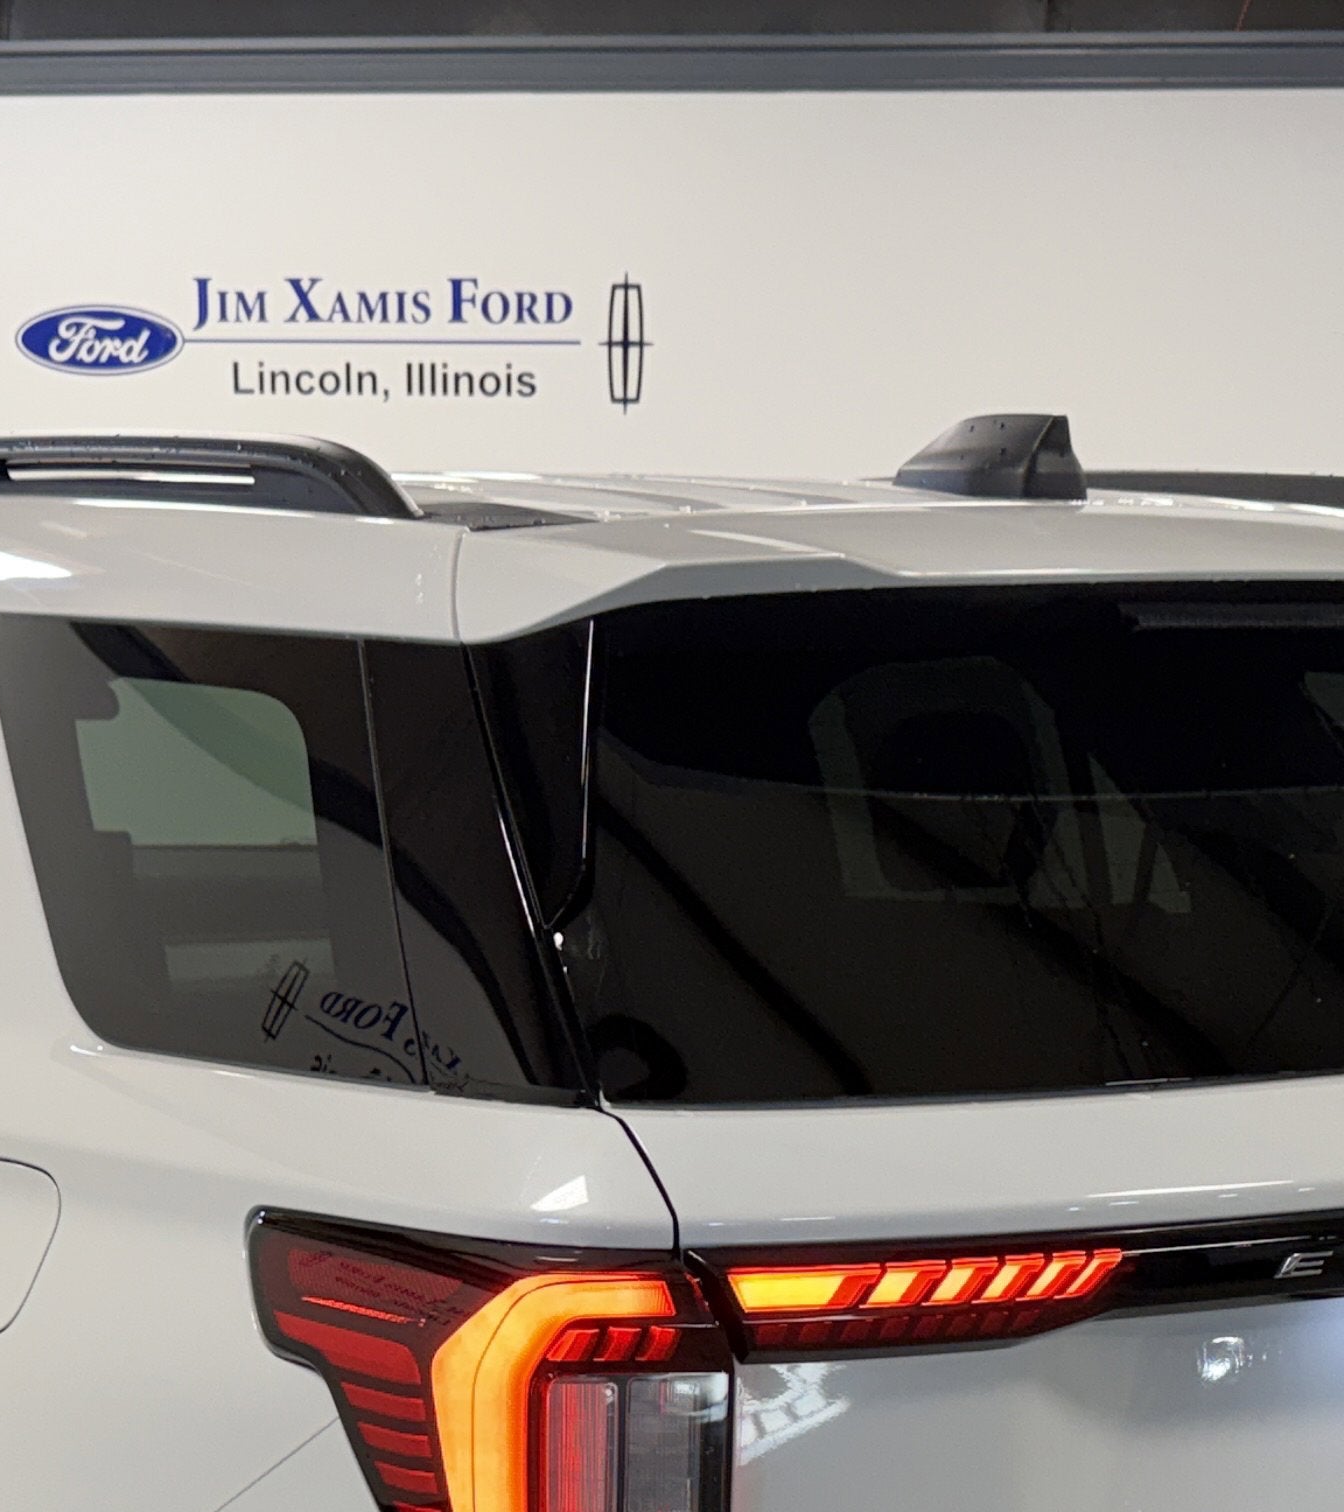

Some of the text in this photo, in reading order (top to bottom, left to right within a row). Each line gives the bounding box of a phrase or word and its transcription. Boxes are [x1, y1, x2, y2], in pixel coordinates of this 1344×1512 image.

[193, 277, 573, 330] JIM XAMIS FORD
[47, 317, 149, 364] Ford
[233, 361, 537, 400] Lincoln, Illinois
